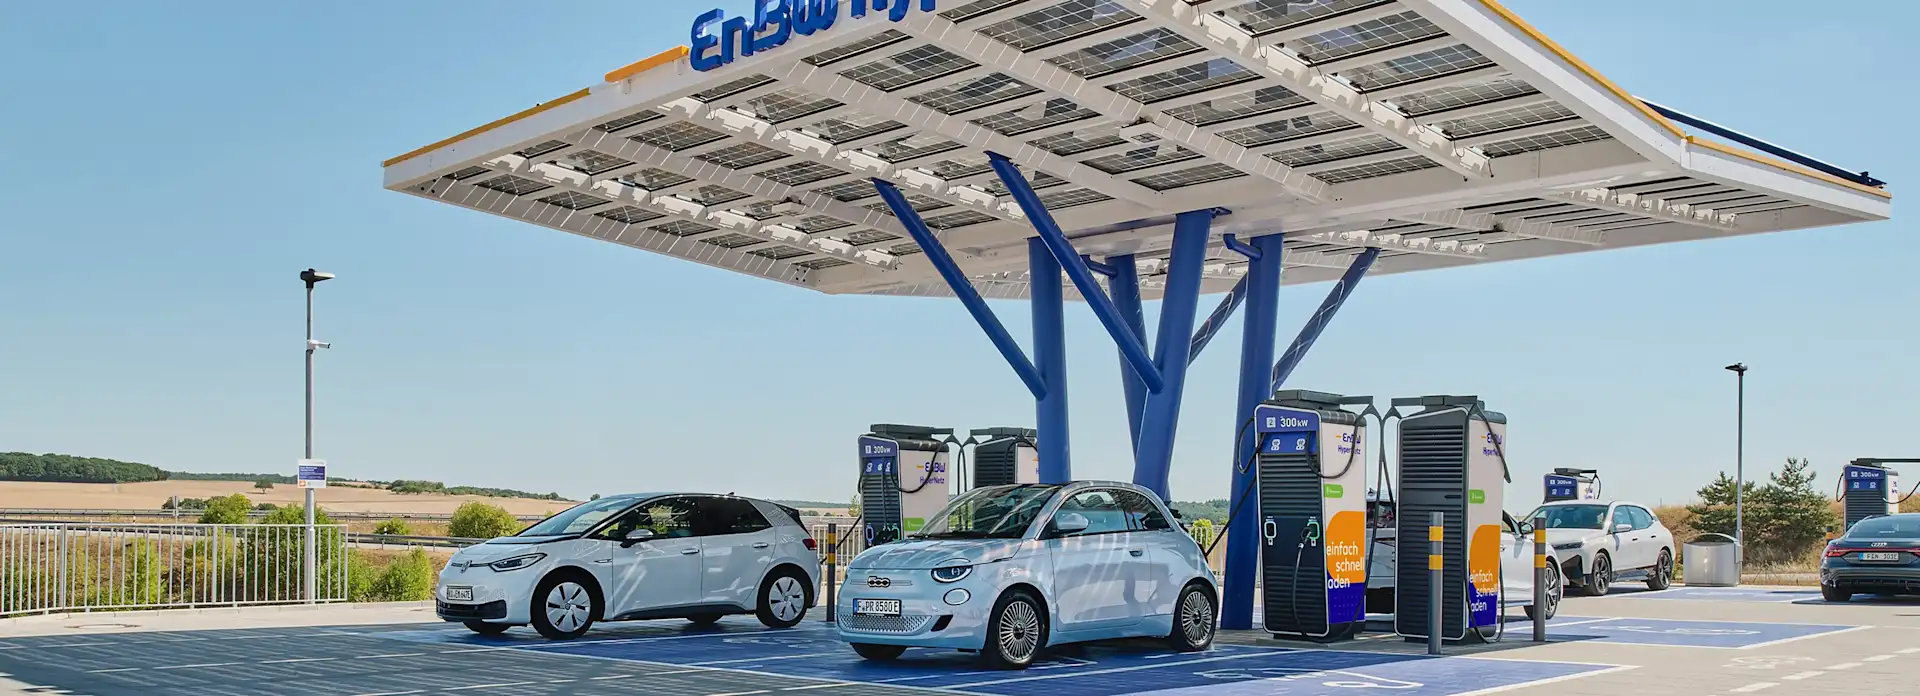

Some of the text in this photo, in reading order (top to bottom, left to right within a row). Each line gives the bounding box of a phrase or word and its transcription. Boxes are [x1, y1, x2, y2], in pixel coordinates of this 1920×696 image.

[925, 462, 946, 473] EBW
[1326, 541, 1359, 556] einfach
[1335, 557, 1365, 572] schnell
[1327, 574, 1351, 589] aden
[1469, 569, 1493, 583] einfach
